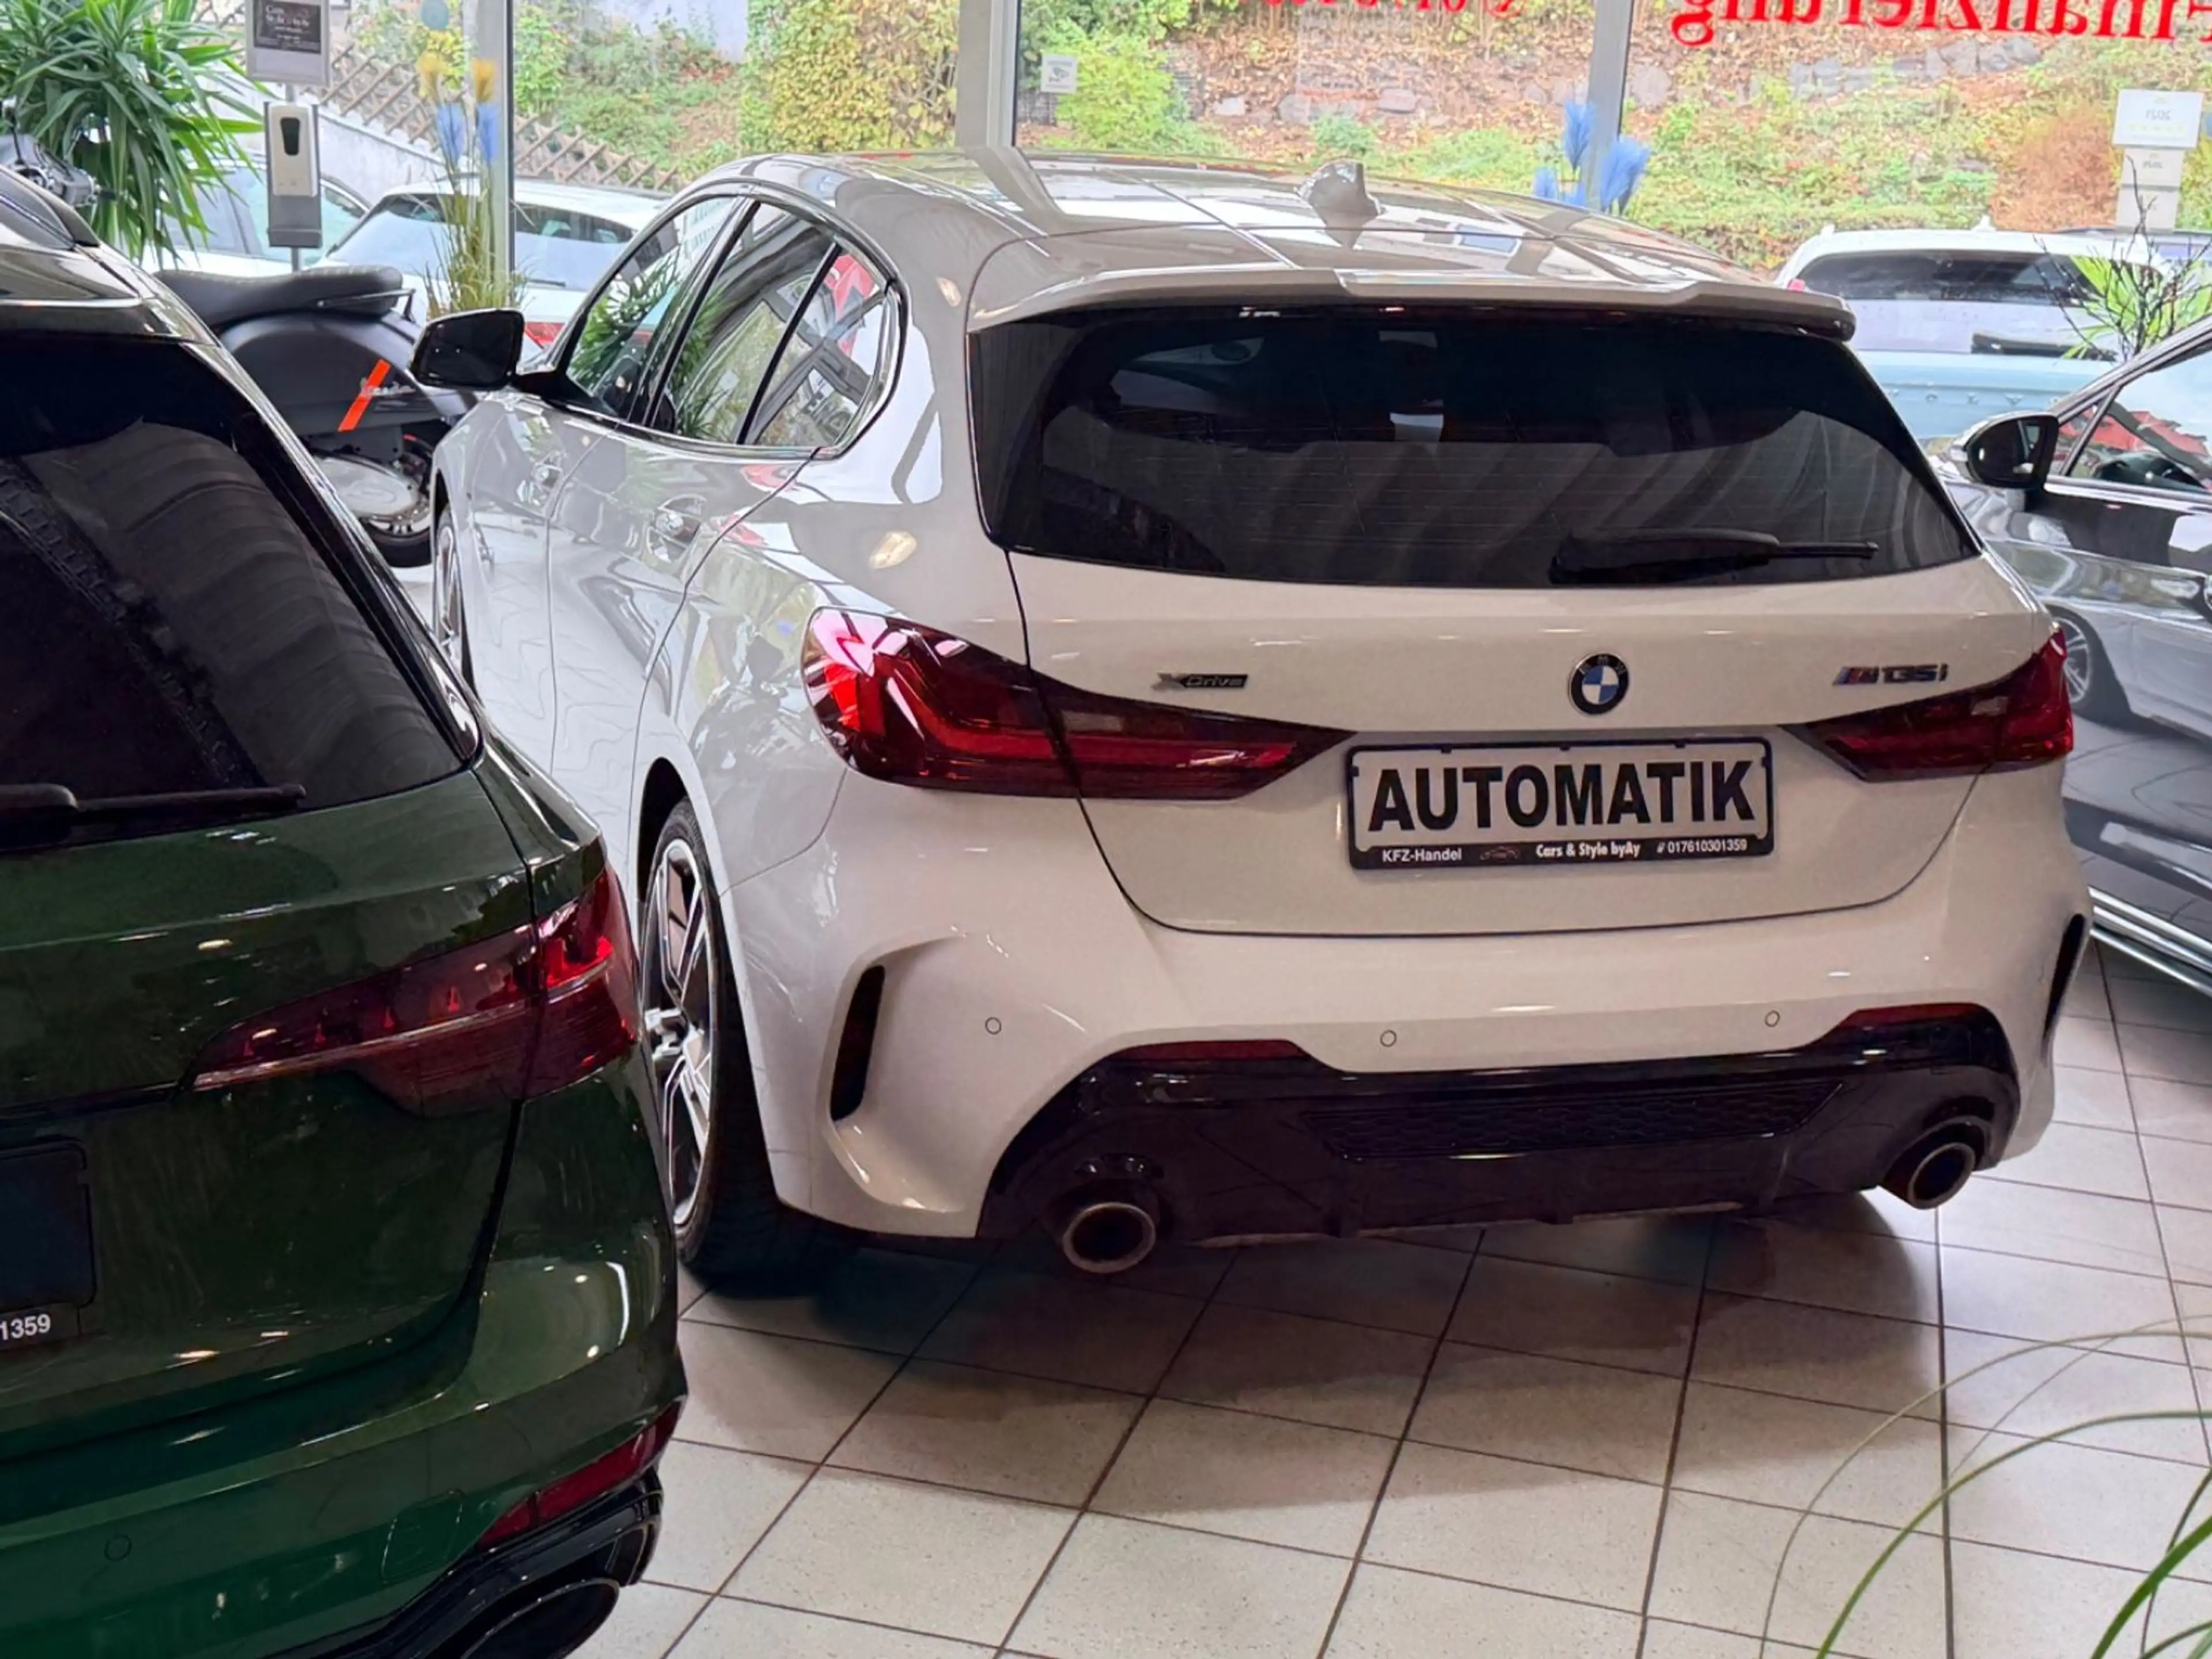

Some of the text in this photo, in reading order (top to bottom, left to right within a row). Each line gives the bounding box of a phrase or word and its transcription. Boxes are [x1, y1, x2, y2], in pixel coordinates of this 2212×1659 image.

[1368, 760, 1755, 831] AUTOMATIK
[1382, 847, 1462, 862] KFZ-Handel
[1536, 844, 1563, 858] Cars
[1566, 843, 1575, 857] &
[1578, 842, 1608, 859] Style
[0, 1313, 51, 1340] 1359
